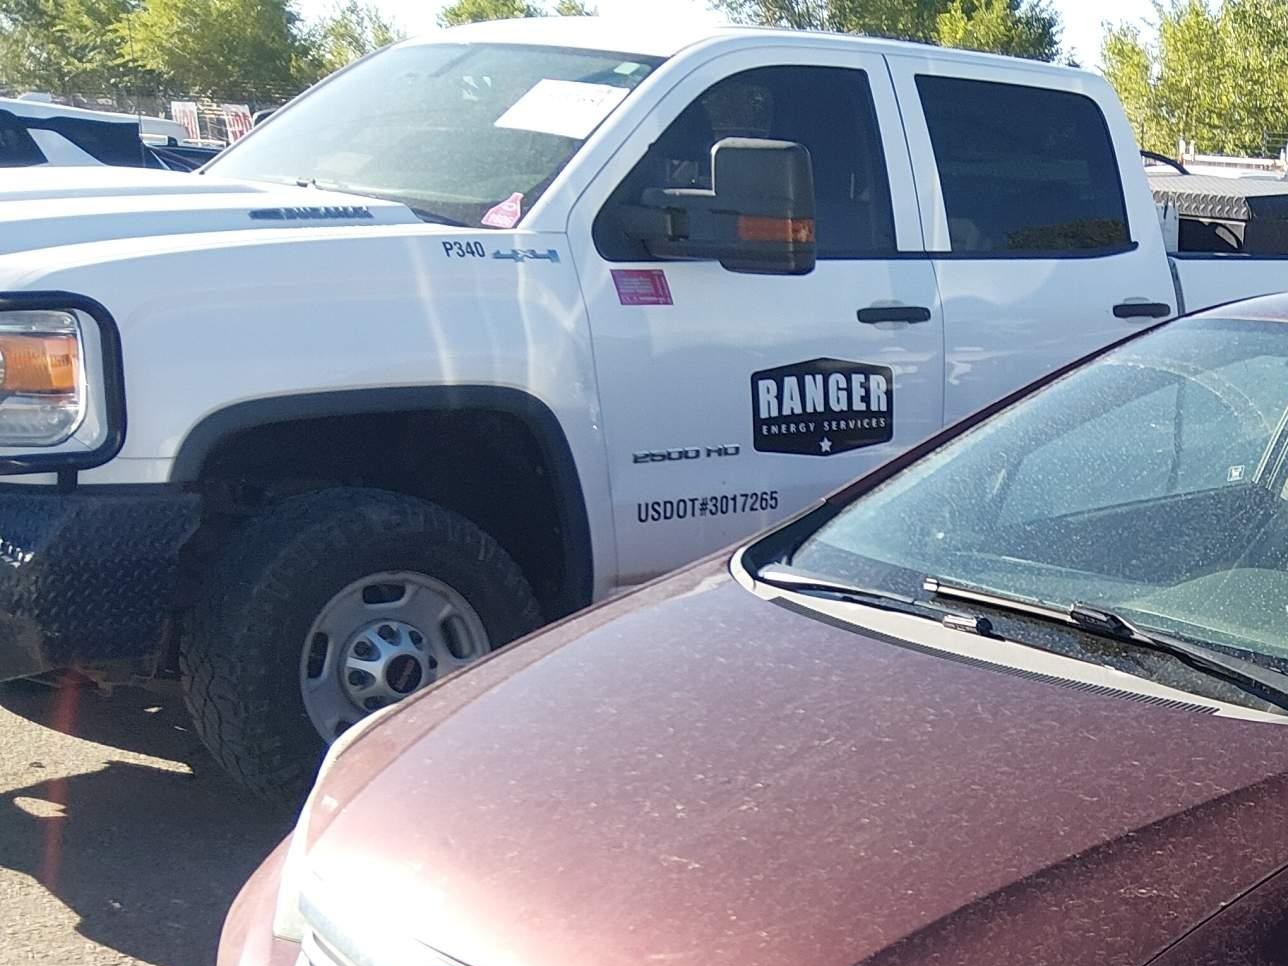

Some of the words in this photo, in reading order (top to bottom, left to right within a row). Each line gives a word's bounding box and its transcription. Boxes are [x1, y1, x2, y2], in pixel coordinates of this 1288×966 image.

[442, 241, 486, 258] P340
[758, 373, 888, 420] RANGER
[762, 421, 816, 435] ENERGY
[823, 417, 887, 432] SERVICES
[633, 447, 701, 463] 2500
[705, 443, 740, 457] HD
[638, 491, 778, 522] USDOT#3017265
